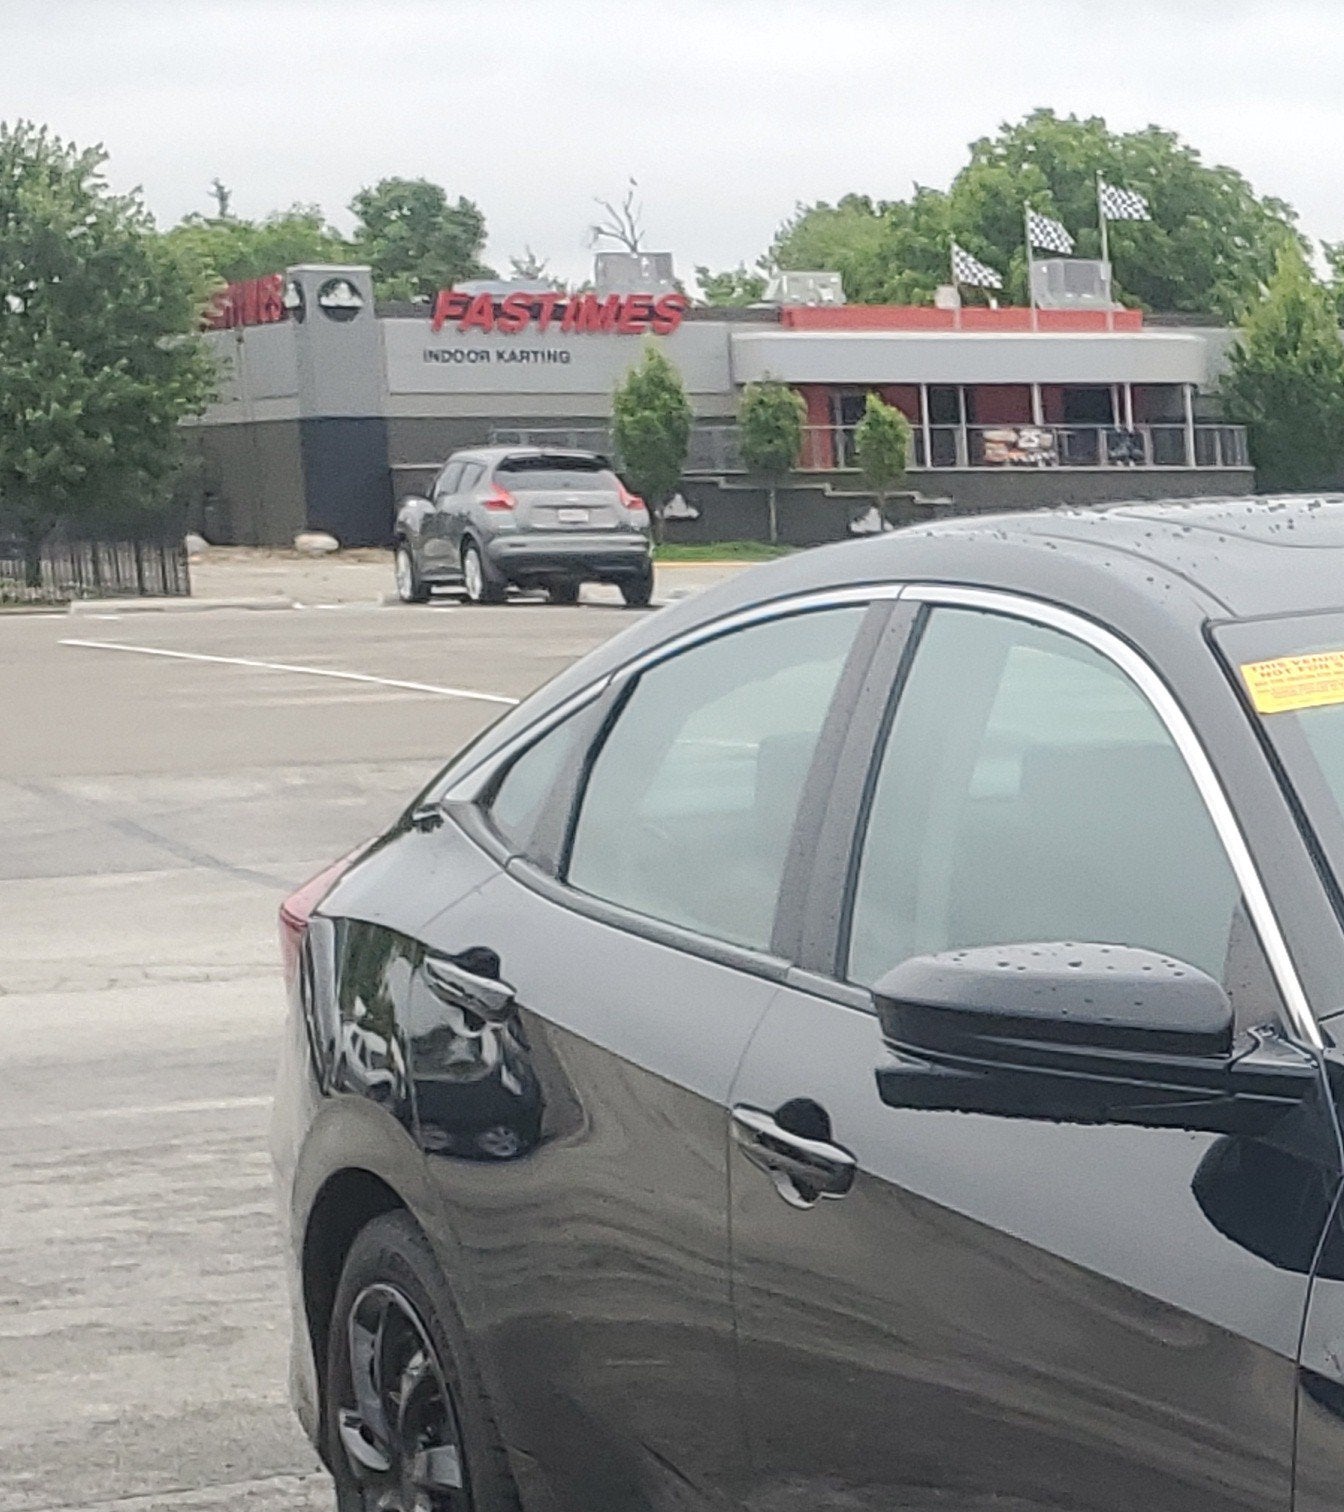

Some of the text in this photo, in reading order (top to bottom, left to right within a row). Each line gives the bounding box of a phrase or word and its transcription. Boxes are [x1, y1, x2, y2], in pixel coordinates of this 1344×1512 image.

[431, 289, 687, 335] FASTIMES
[423, 349, 571, 364] INDOOR KARTING
